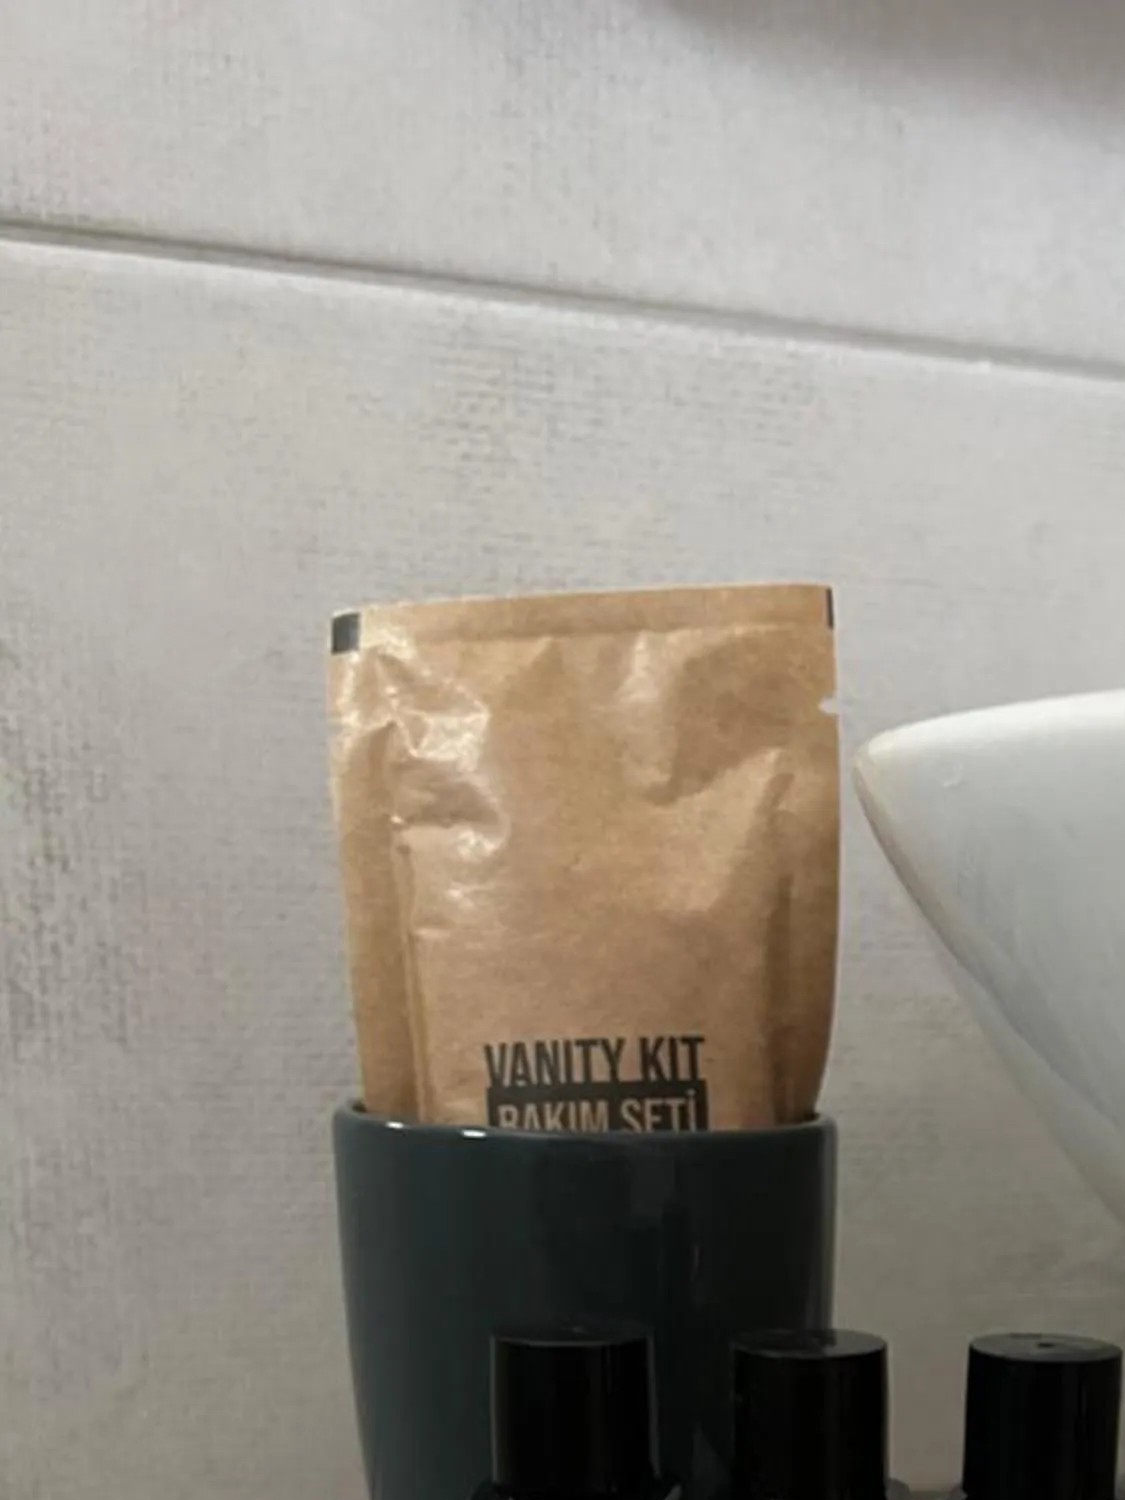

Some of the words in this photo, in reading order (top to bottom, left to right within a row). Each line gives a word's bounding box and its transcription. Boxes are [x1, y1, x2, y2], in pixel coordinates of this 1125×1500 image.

[484, 1038, 625, 1086] VANITY
[639, 1035, 705, 1083] KIT
[497, 1099, 609, 1132] BAKIM
